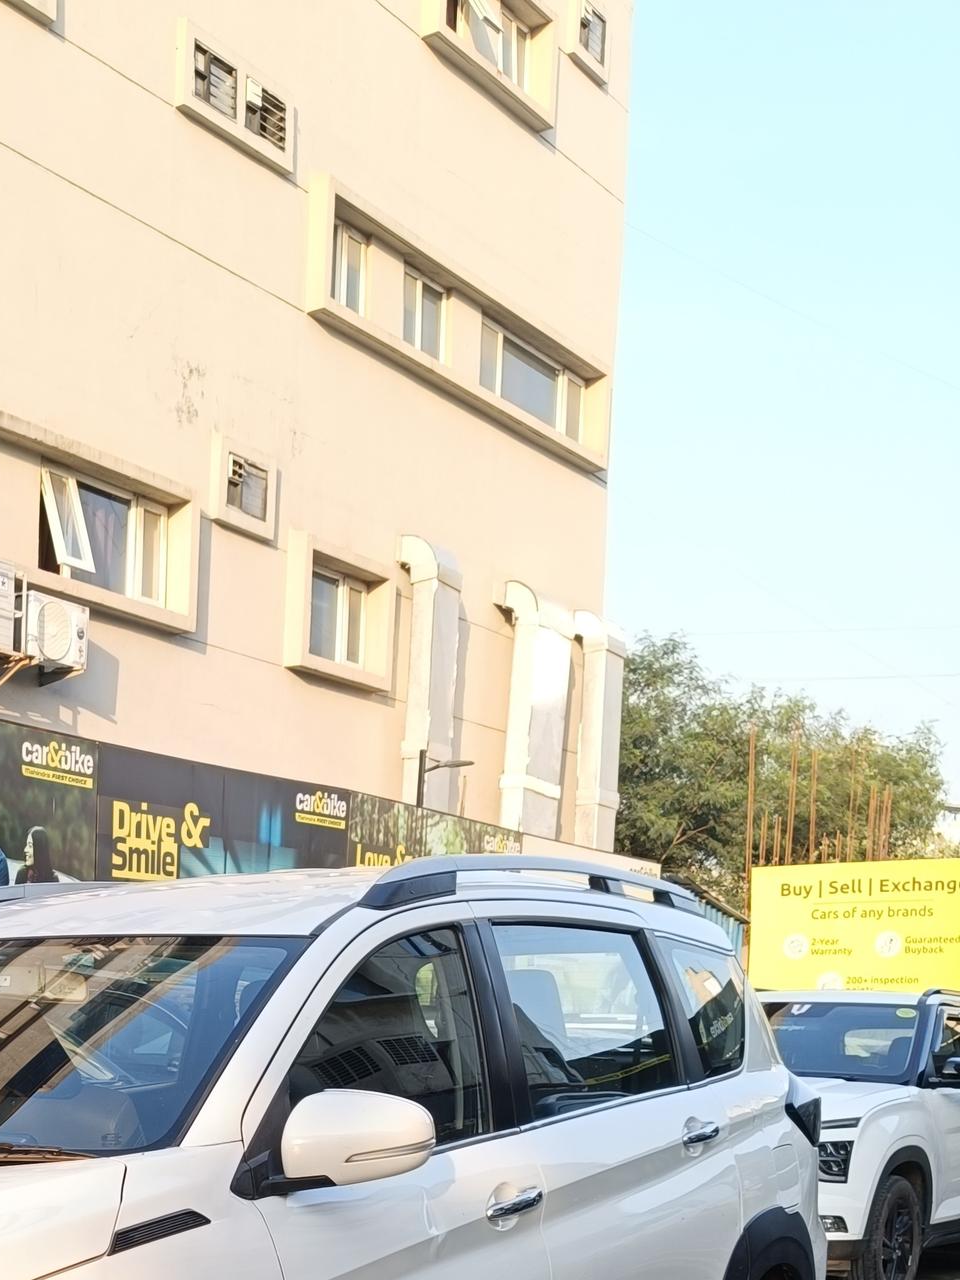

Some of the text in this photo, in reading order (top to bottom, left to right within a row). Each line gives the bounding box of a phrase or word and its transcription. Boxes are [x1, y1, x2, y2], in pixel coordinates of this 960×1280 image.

[21, 740, 94, 775] car&bike
[112, 799, 211, 849] Drive &
[111, 836, 176, 877] Smile
[780, 882, 813, 899] Buy
[828, 878, 863, 895] Sell
[879, 876, 960, 894] Exchang
[811, 905, 934, 921] Cars of any brands
[905, 935, 960, 944] Guaranteed
[811, 947, 853, 956] Warranty
[904, 945, 944, 955] Buyback
[870, 976, 919, 985] inspection
